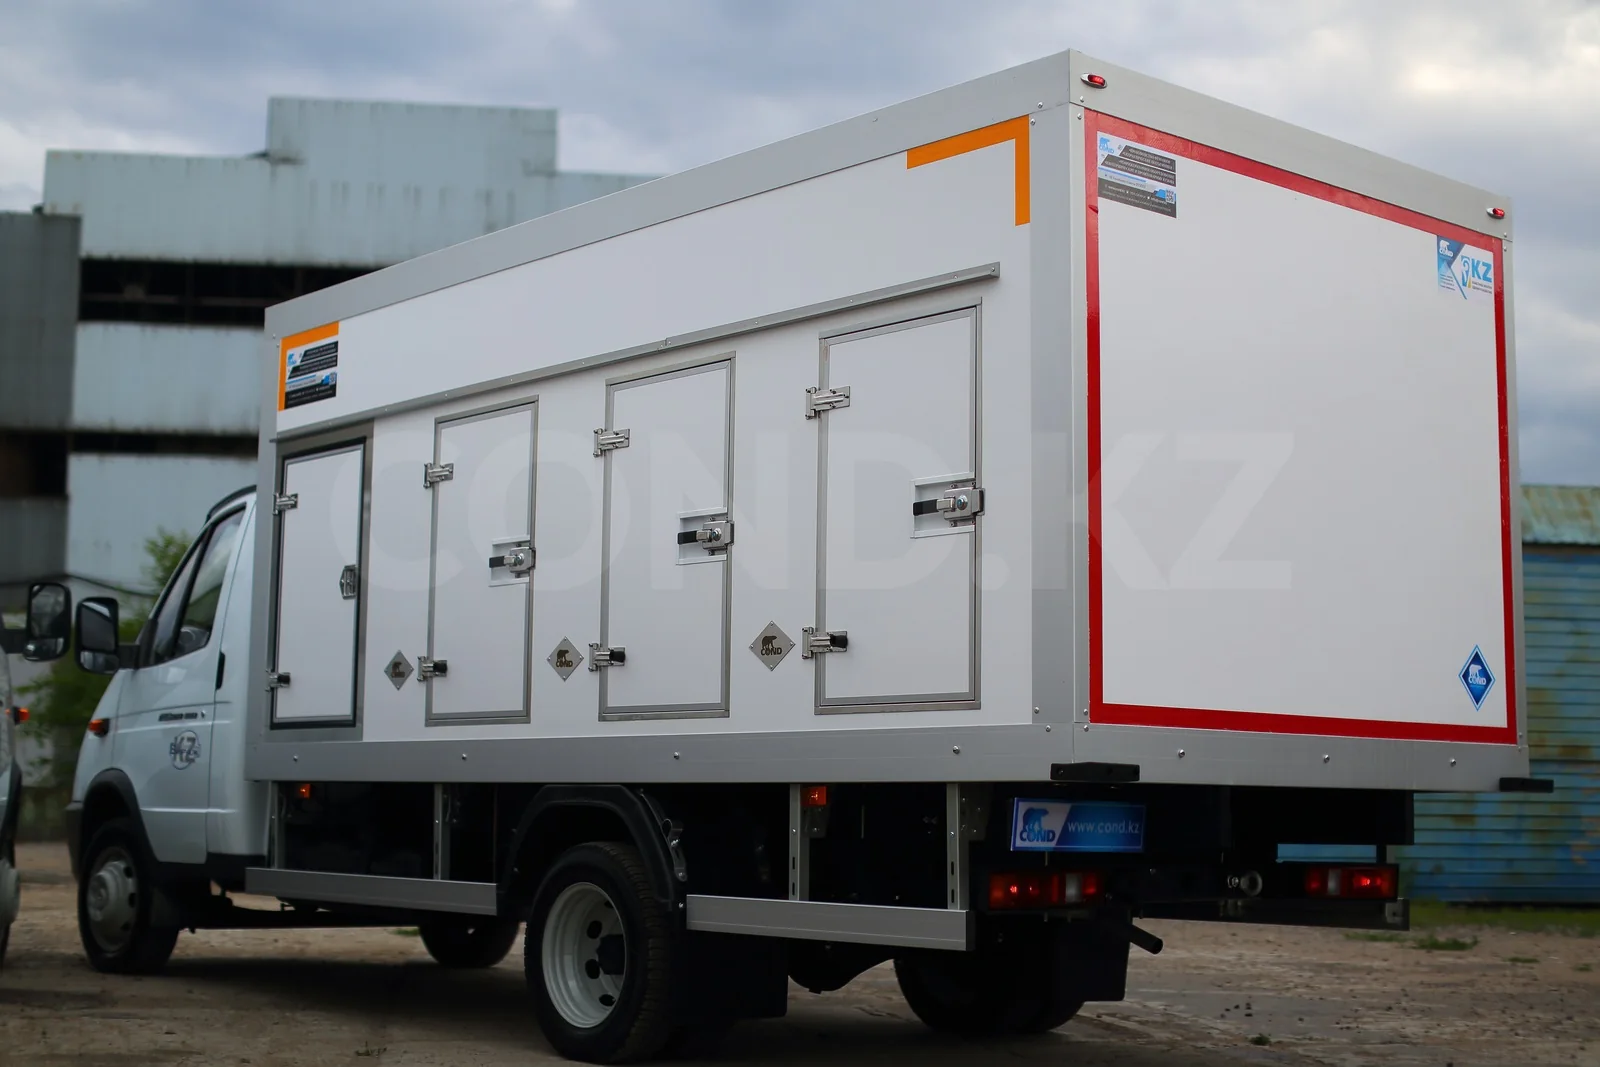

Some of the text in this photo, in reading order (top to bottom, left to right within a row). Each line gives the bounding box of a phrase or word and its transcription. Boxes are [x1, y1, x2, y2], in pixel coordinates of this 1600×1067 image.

[760, 647, 782, 656] COND
[1067, 820, 1140, 834] www.cond.kz
[1019, 829, 1056, 843] COND
